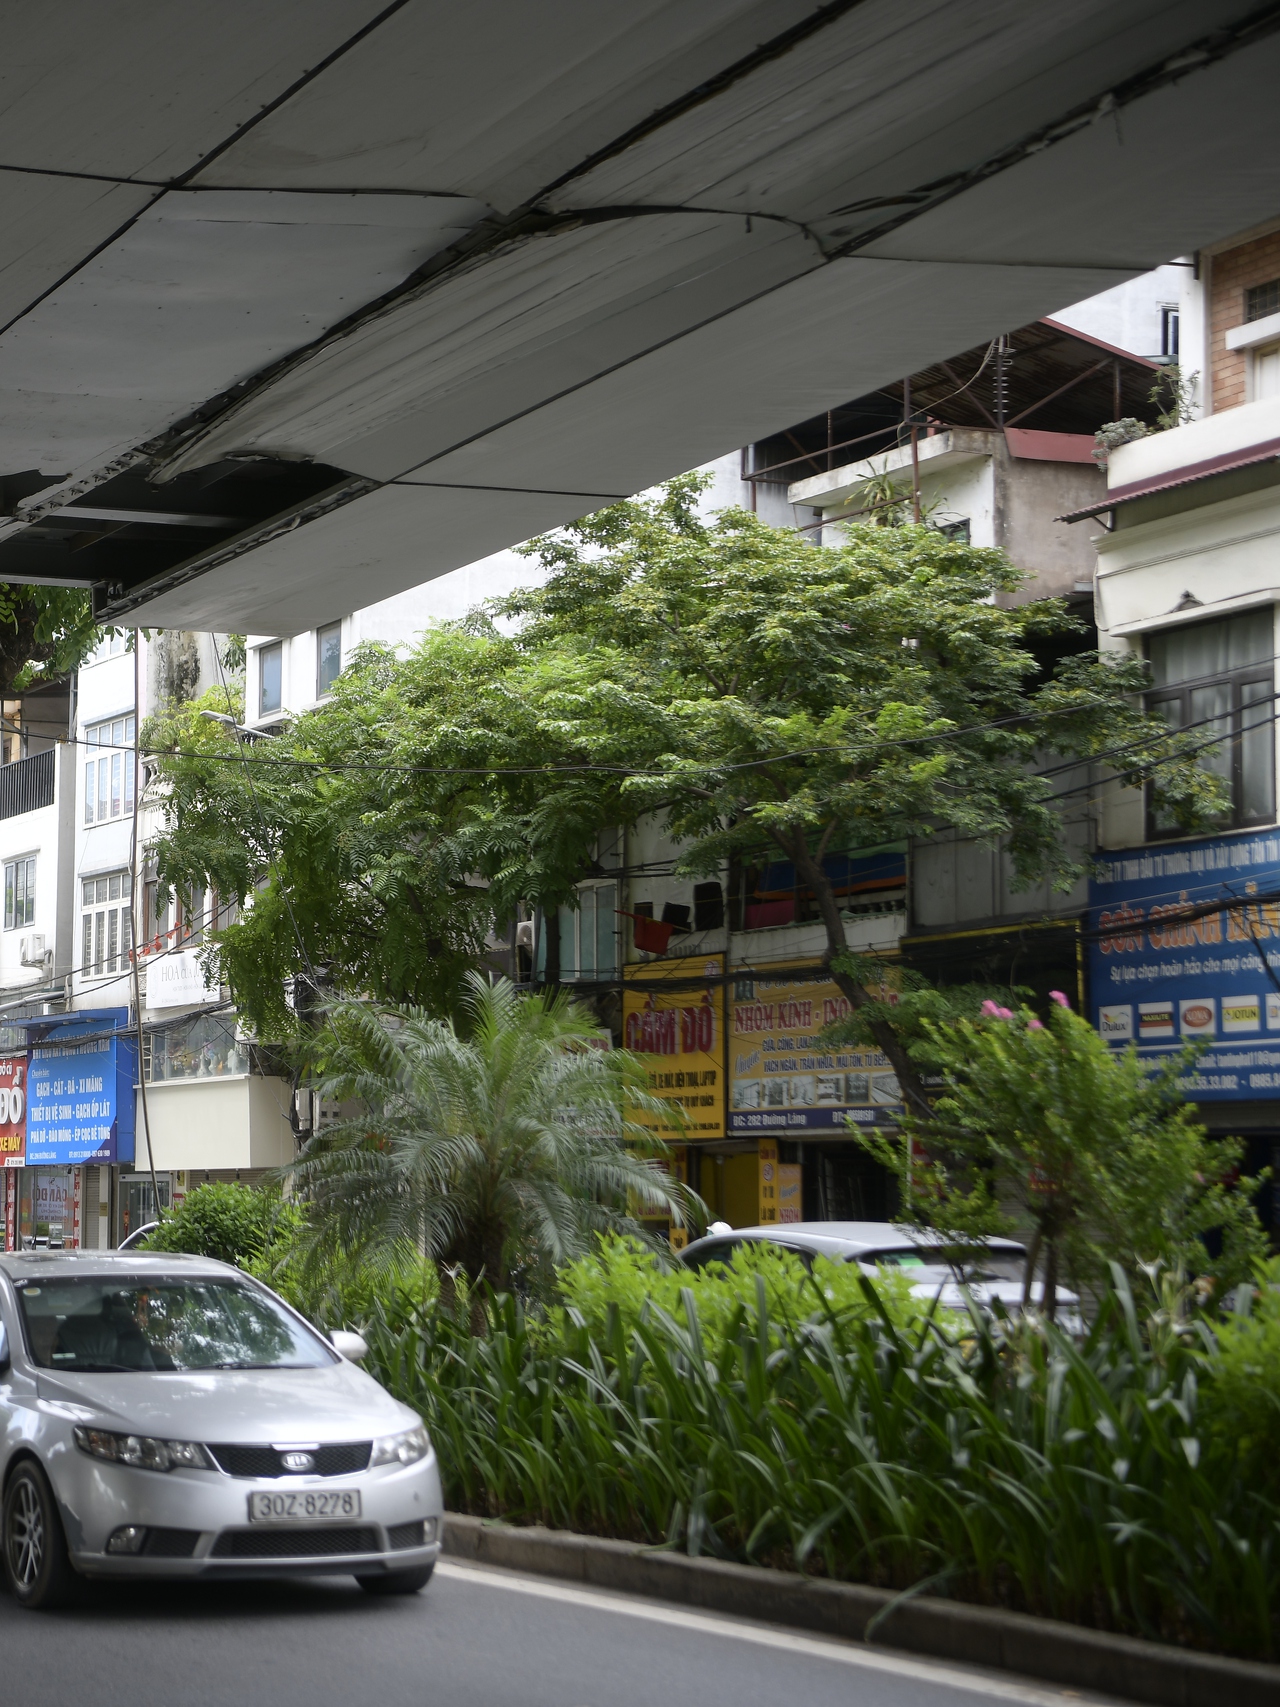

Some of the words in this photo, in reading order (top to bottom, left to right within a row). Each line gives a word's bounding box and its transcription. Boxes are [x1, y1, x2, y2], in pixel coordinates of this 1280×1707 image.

[1137, 963, 1159, 982] chọn
[1160, 959, 1182, 977] hoàn
[1184, 956, 1202, 975] hảo
[1202, 957, 1221, 974] cho
[1222, 954, 1239, 976] mọi
[626, 991, 679, 1055] CẦM
[682, 988, 715, 1054] ĐỒ
[734, 997, 775, 1034] NHÔM
[778, 994, 813, 1030] KÍNH
[1142, 1013, 1170, 1021] MAXILITE
[1186, 1010, 1209, 1021] KOVA
[1230, 1008, 1257, 1019] JOTUN
[1103, 1021, 1127, 1032] Dulux
[36, 1082, 50, 1100] GẠCH
[54, 1076, 64, 1096] CÁT
[68, 1076, 75, 1094] ĐÁ
[86, 1075, 103, 1093] MĂNG
[31, 1102, 44, 1122] THIẾT
[46, 1106, 51, 1124] BỊ
[52, 1103, 58, 1124] VỆ
[59, 1105, 72, 1120] SINH
[76, 1102, 90, 1122] GẠCH
[92, 1098, 99, 1117] ỐP
[100, 1098, 110, 1117] LÁT
[747, 1114, 761, 1126] 282
[762, 1112, 787, 1126] Đường
[788, 1112, 807, 1126] Láng
[0, 1136, 7, 1152] XE
[8, 1132, 21, 1152] MÁY
[30, 1128, 39, 1144] PHÁ
[74, 1126, 80, 1141] ÉP
[81, 1128, 91, 1144] CỌC
[91, 1125, 97, 1140] BÊ
[98, 1124, 110, 1140] TÔNG
[260, 1494, 353, 1516] 30Z-8278
